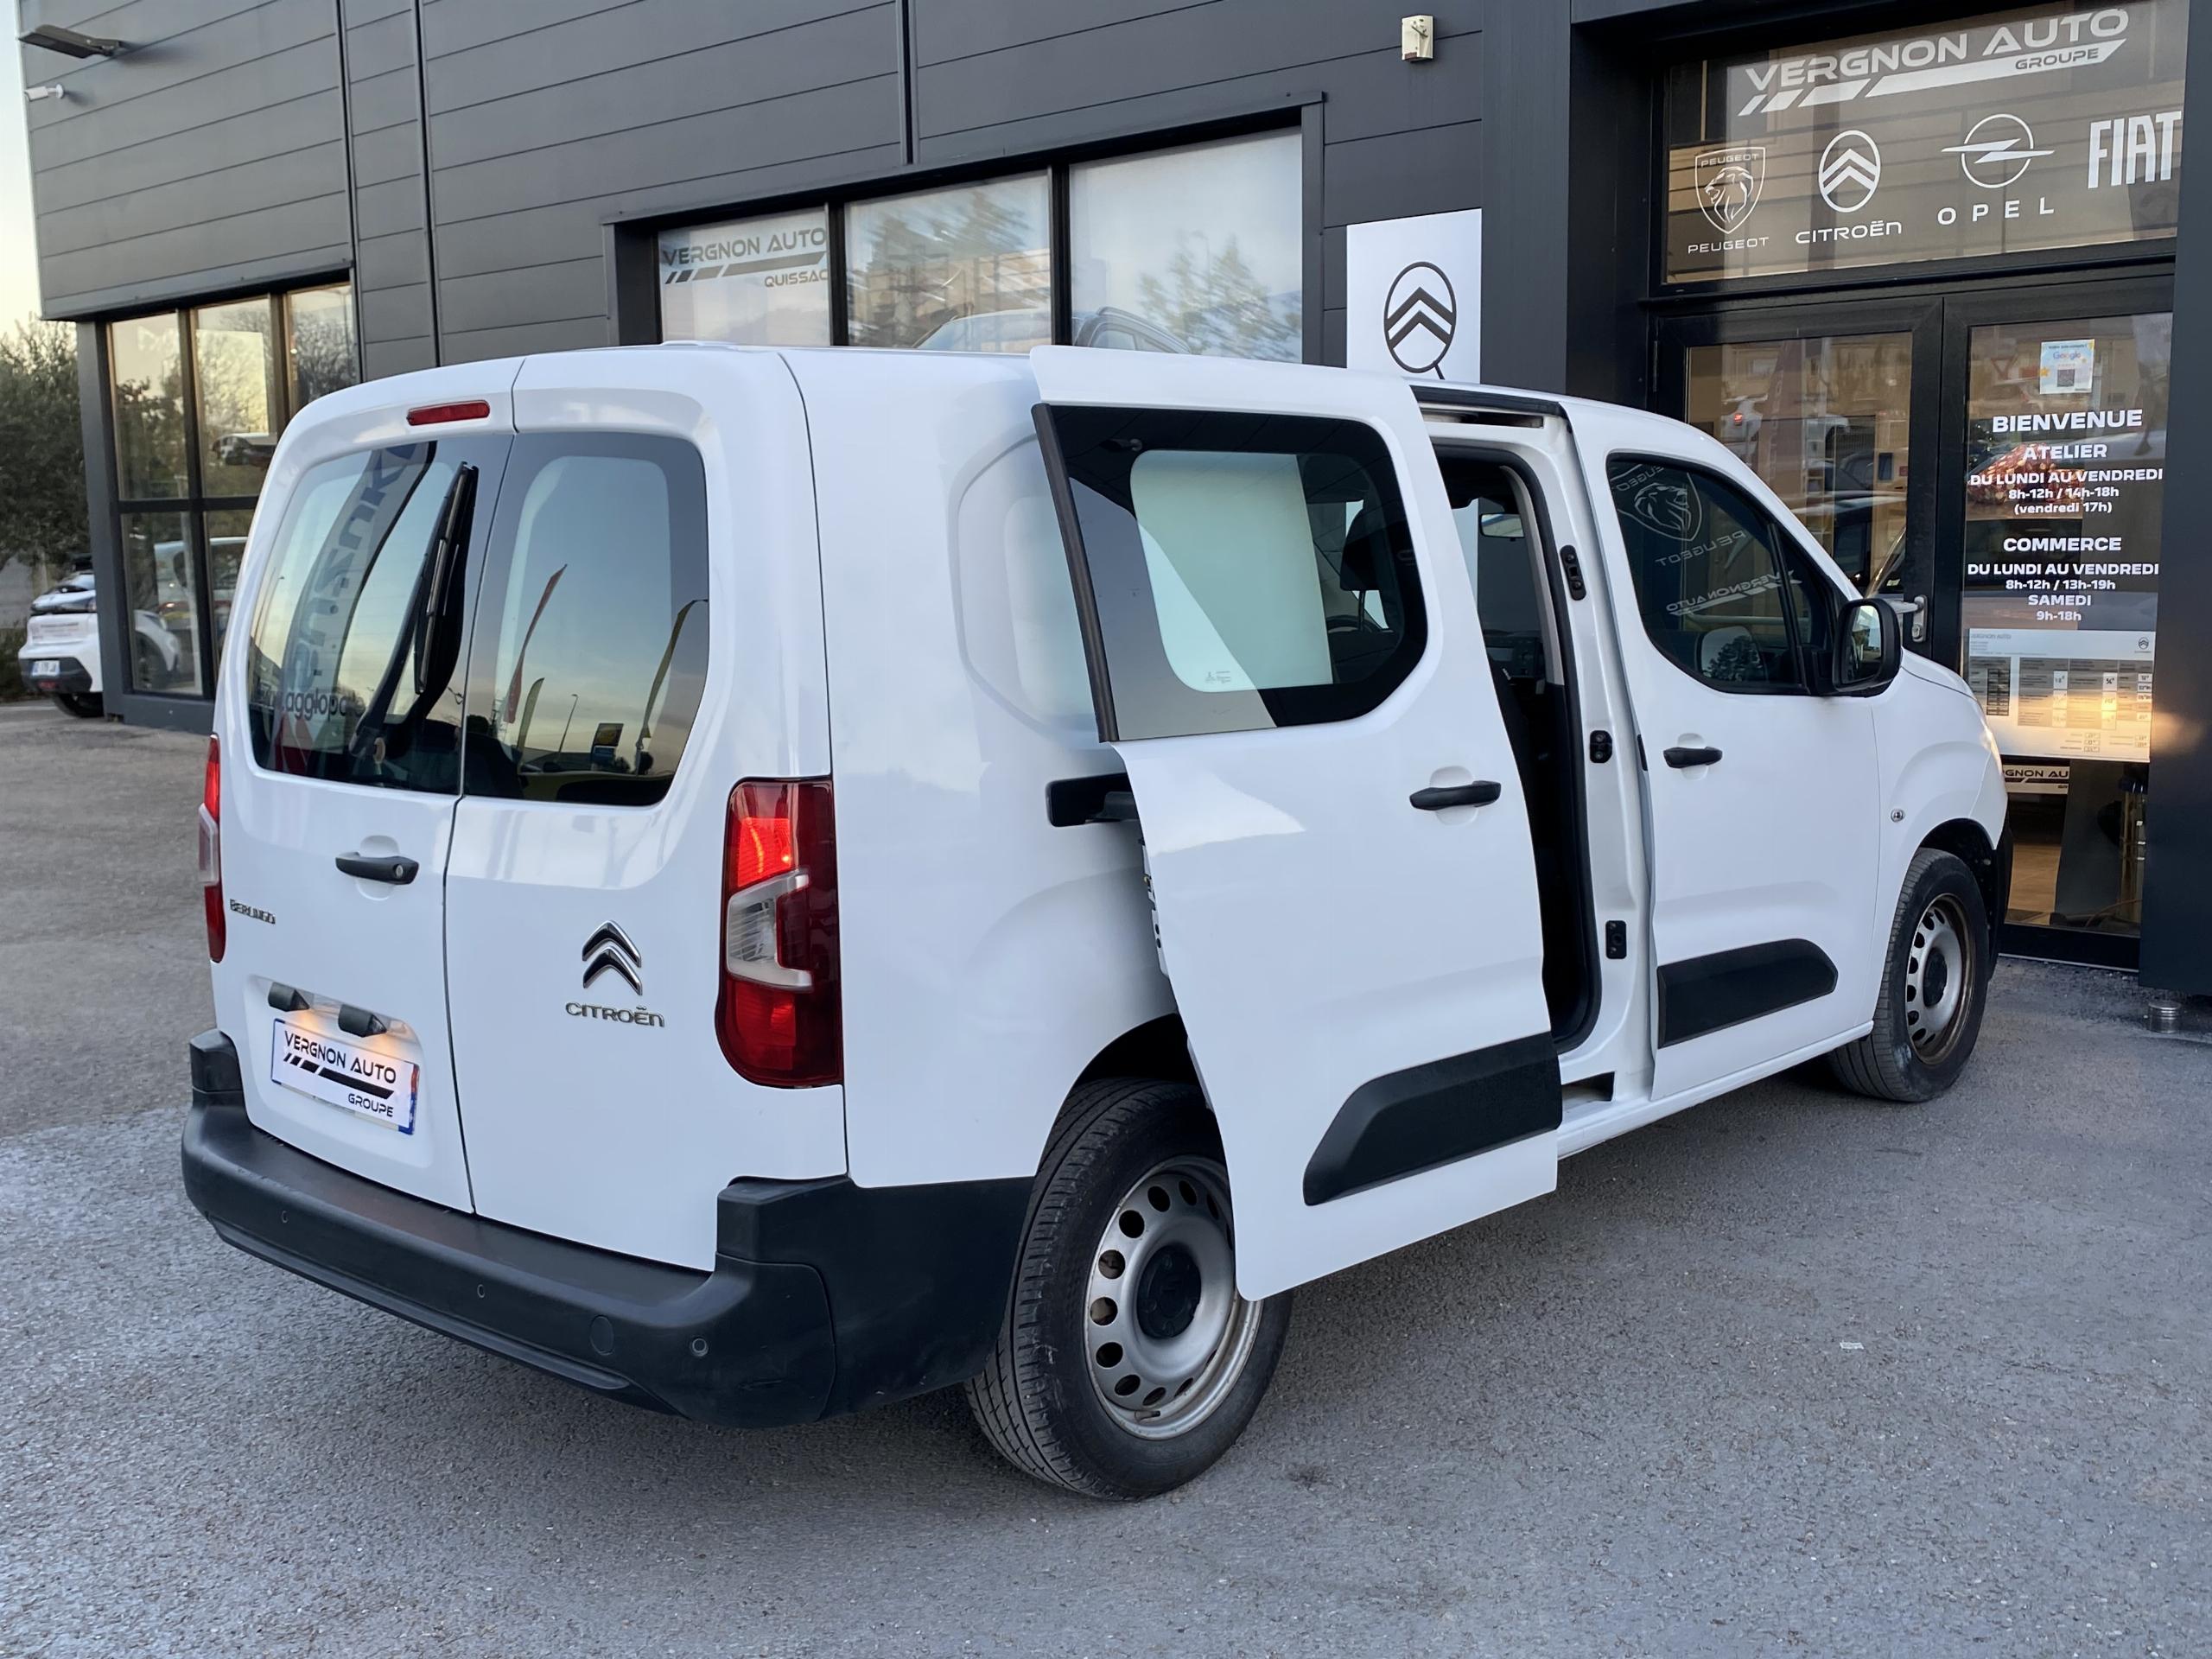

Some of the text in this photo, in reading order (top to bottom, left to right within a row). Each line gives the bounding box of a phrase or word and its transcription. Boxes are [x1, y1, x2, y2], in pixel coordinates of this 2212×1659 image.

[1745, 8, 2129, 92] VERGNON AUTO
[2015, 48, 2099, 71] GROUPE
[2088, 111, 2182, 188] FIAT
[1700, 153, 1759, 168] PEUGEOT
[1937, 197, 2055, 226] OPEL
[663, 227, 826, 266] VERGNON AUTO
[1688, 237, 1770, 254] PEUGEOT
[764, 269, 829, 288] QUISSAC
[1993, 409, 2143, 433] BIENVENUE
[2023, 444, 2107, 460] ATELIER
[1970, 468, 2164, 486] DU LUNDI AU VENDREDI
[2009, 488, 2054, 499] 8h-12h
[2067, 486, 2120, 499] 14h-18h
[2014, 501, 2113, 516] (vendredi 17h)
[2003, 537, 2122, 552] COMMERCE
[1967, 563, 2159, 575] DU LUNDI AU VENDREDI
[2005, 579, 2050, 589] 8h-12h
[2063, 579, 2116, 589] 13h-19h
[2028, 594, 2092, 607] SAMEDI
[2036, 610, 2082, 621] 9h-18h
[2003, 769, 2044, 778] GNON
[284, 1030, 397, 1084] VERGNON AUTO
[347, 1092, 394, 1117] GROUPE
